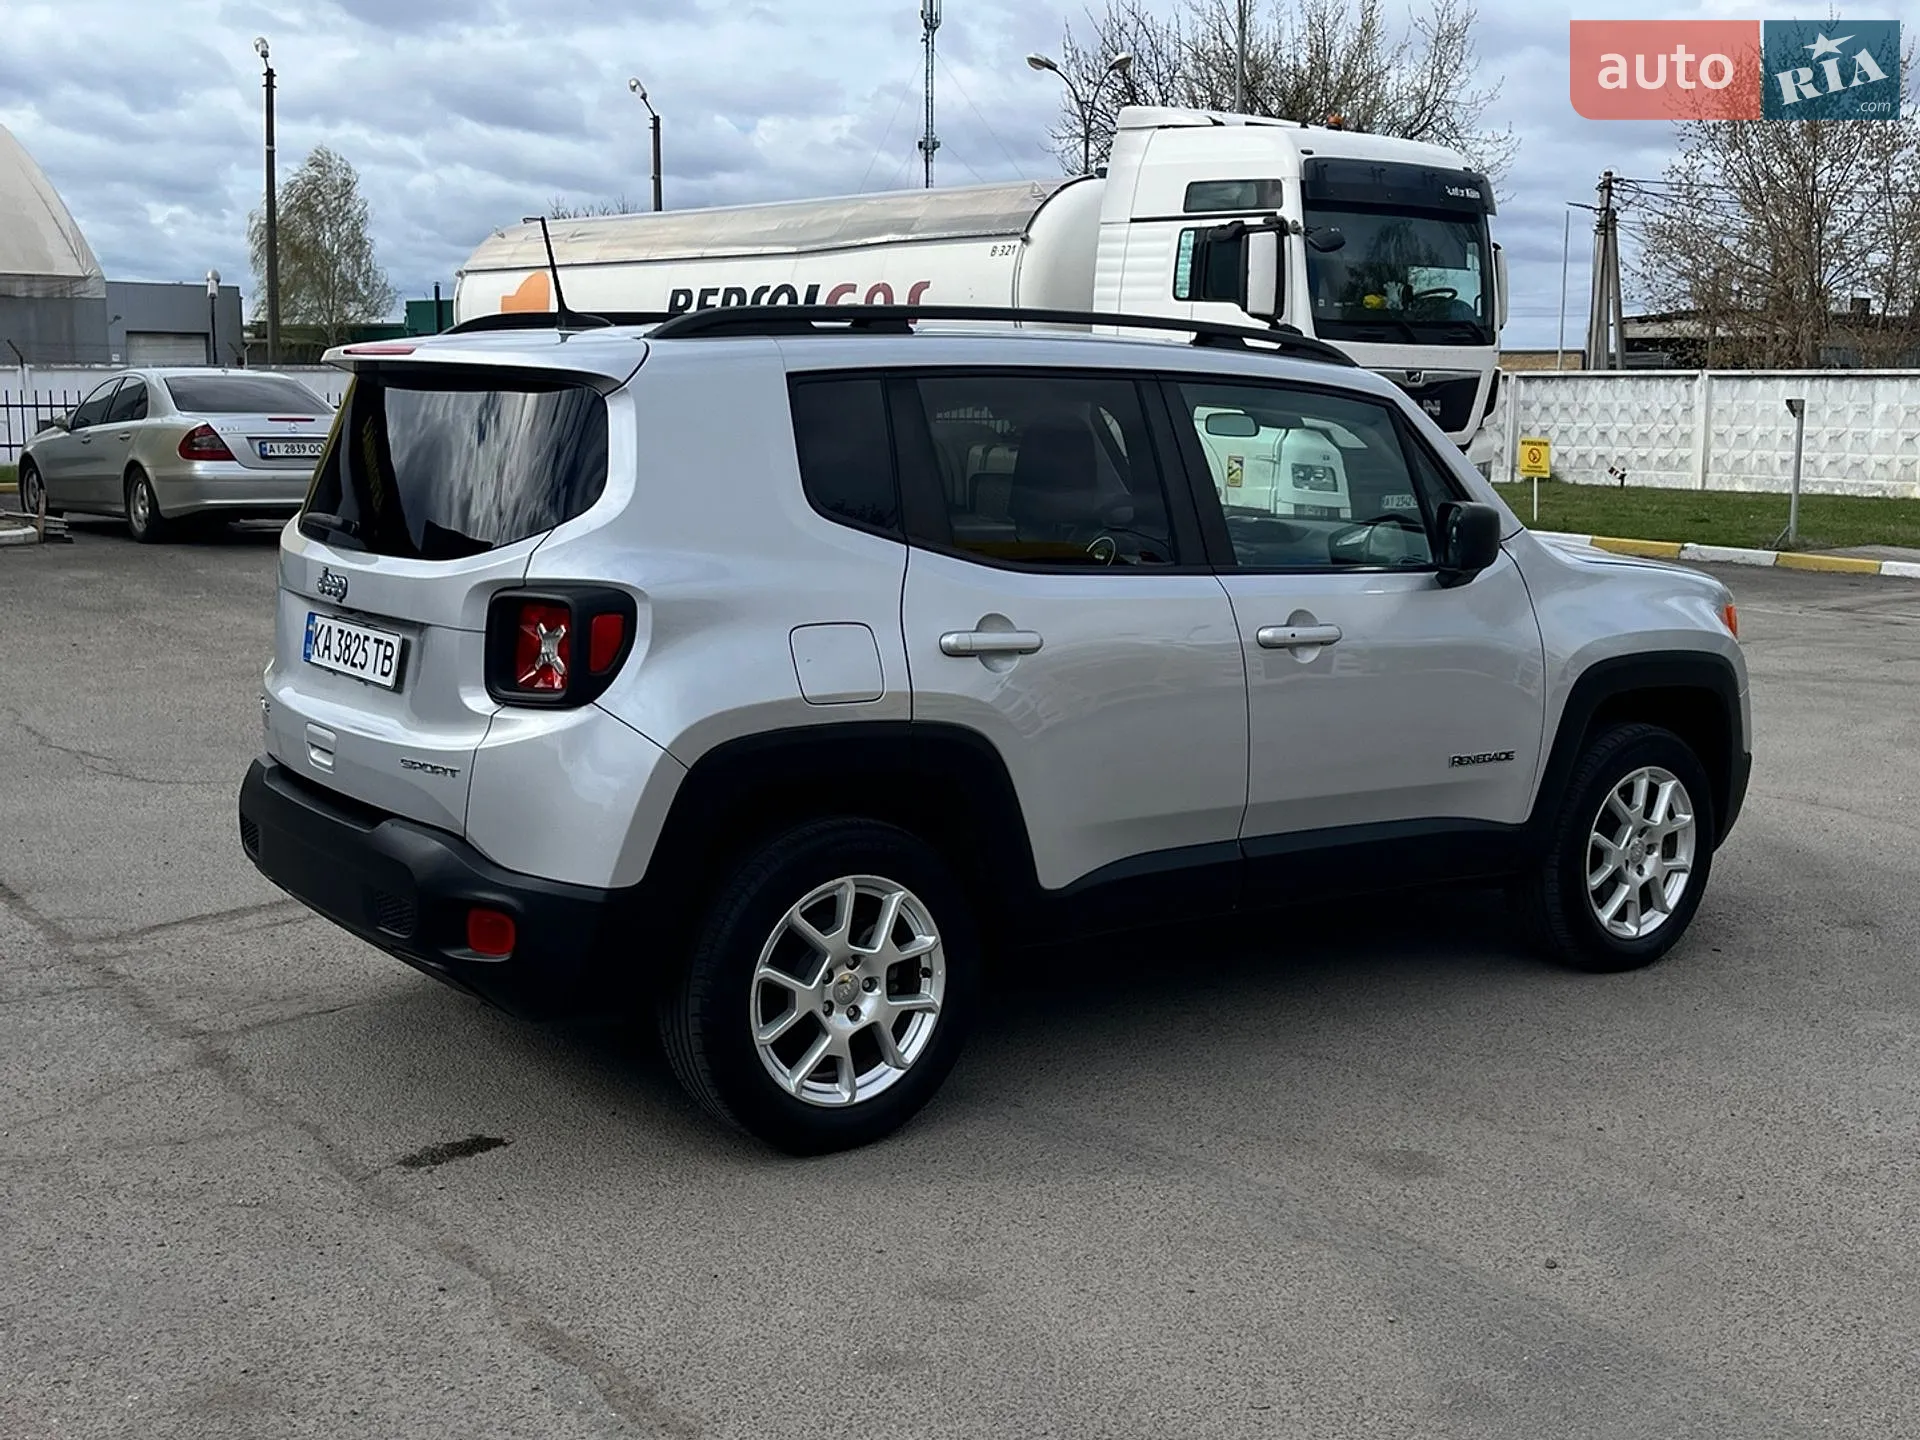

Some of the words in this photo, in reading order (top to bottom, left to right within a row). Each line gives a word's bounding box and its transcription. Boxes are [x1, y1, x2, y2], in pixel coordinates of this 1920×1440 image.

[284, 444, 306, 455] 2839
[317, 566, 348, 603] Jeep
[312, 622, 333, 660] KA
[334, 628, 370, 671] 3825
[372, 637, 395, 678] TB
[400, 758, 461, 778] SPORT
[1449, 750, 1516, 768] RENEGADE
